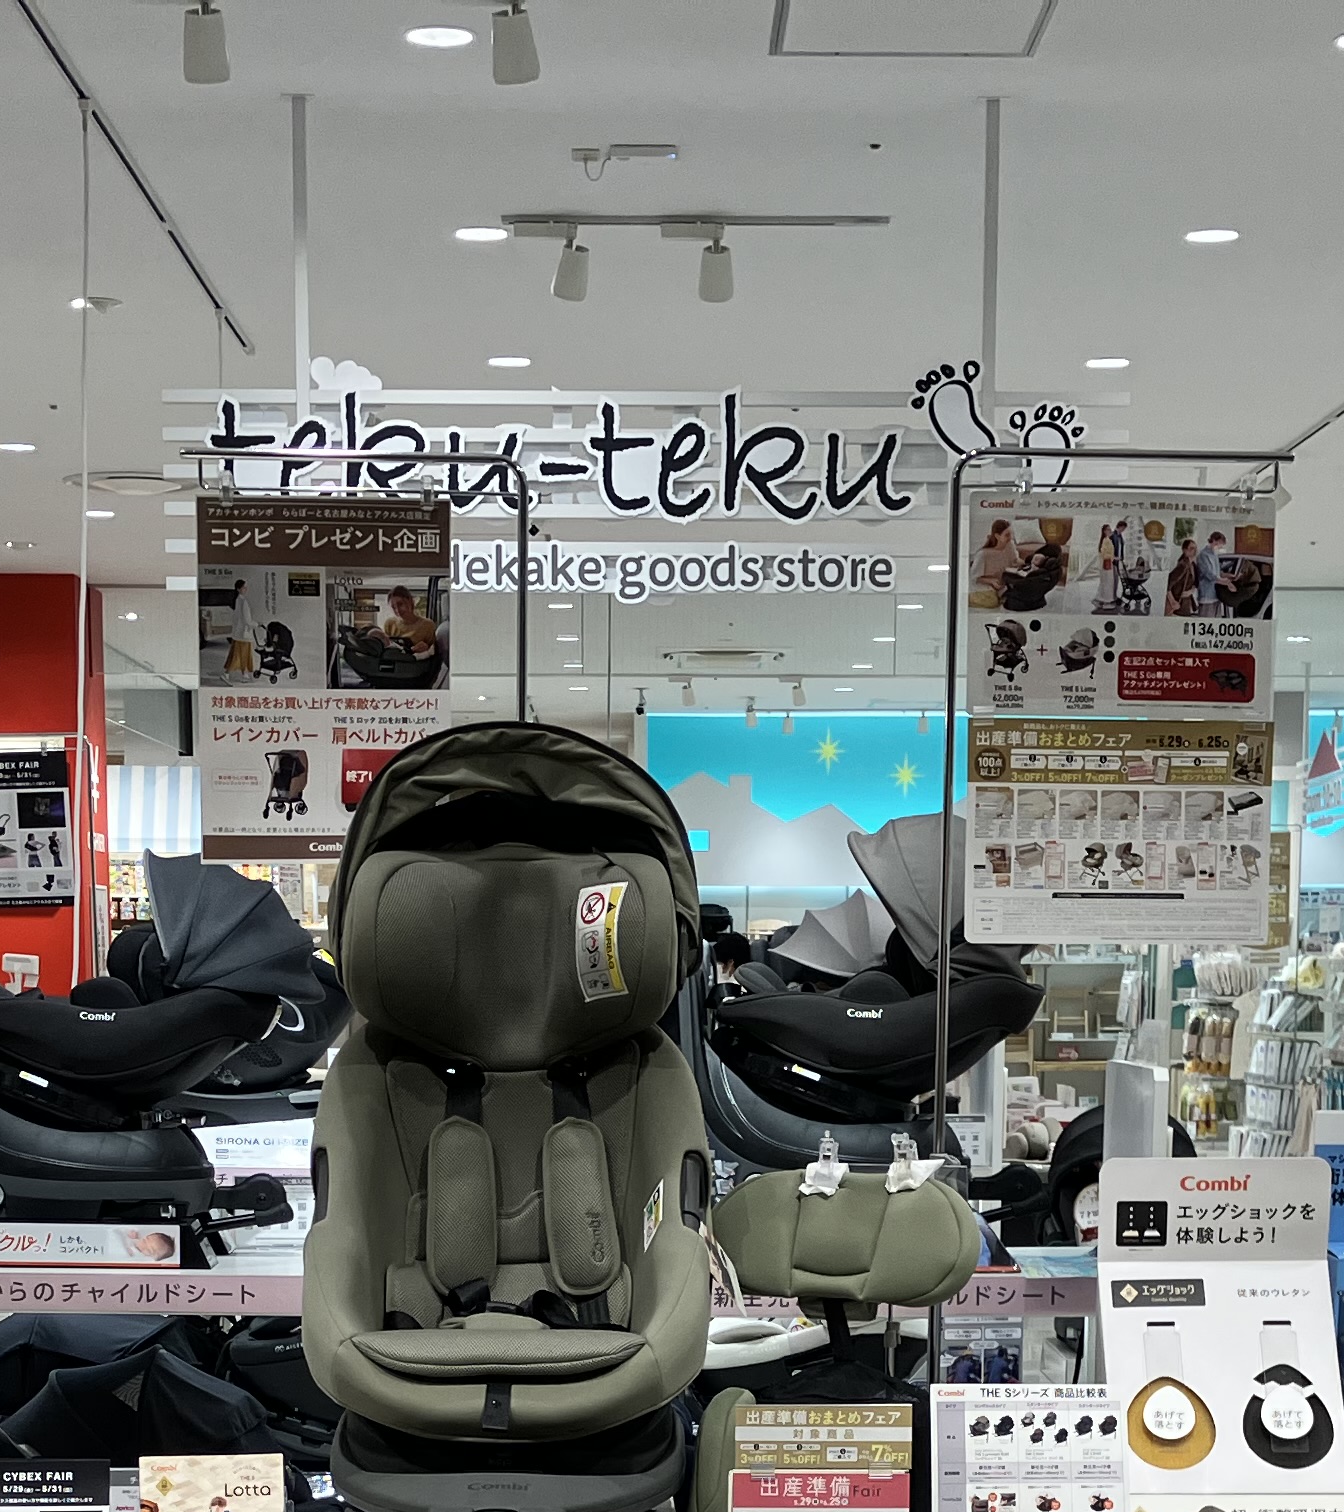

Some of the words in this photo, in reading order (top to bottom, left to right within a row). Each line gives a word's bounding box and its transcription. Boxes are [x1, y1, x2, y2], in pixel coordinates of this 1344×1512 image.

[210, 526, 274, 549] コンビ
[285, 527, 441, 554] プレゼント企画
[453, 539, 605, 589] dekake
[617, 541, 764, 601] goods
[773, 546, 893, 589] store
[334, 575, 364, 587] Lotta
[1190, 622, 1253, 638] 134,000円
[1124, 657, 1210, 668] 左記2点セットご購入で
[212, 696, 439, 711] 対象商品をお買い上げで素敵なプレゼント!
[212, 727, 318, 743] レインカバー
[976, 731, 1132, 747] 出産準備おまとめフェア
[79, 1010, 116, 1022] Combi
[846, 1007, 884, 1019] Combi
[1180, 1175, 1251, 1192] Combi
[1176, 1202, 1316, 1222] エッグショックを
[1176, 1227, 1276, 1244] 体験しよう!
[1236, 1288, 1311, 1298] 従来のウレタン
[980, 1388, 1000, 1398] THE
[1005, 1388, 1049, 1398] Sシリーズ
[1054, 1388, 1107, 1399] 商品比較表
[746, 1410, 901, 1426] 出産準備おまとめフェア
[1153, 1410, 1185, 1420] あげて
[1271, 1410, 1303, 1420] あげて
[1153, 1419, 1185, 1431] 落とす
[1272, 1419, 1304, 1430] 落とす
[3, 1472, 42, 1482] CYBEX
[46, 1471, 73, 1481] FAIR
[224, 1483, 271, 1498] Lotta
[467, 1482, 530, 1492] Combi
[760, 1476, 851, 1497] 出産準備
[853, 1486, 882, 1498] Fair
